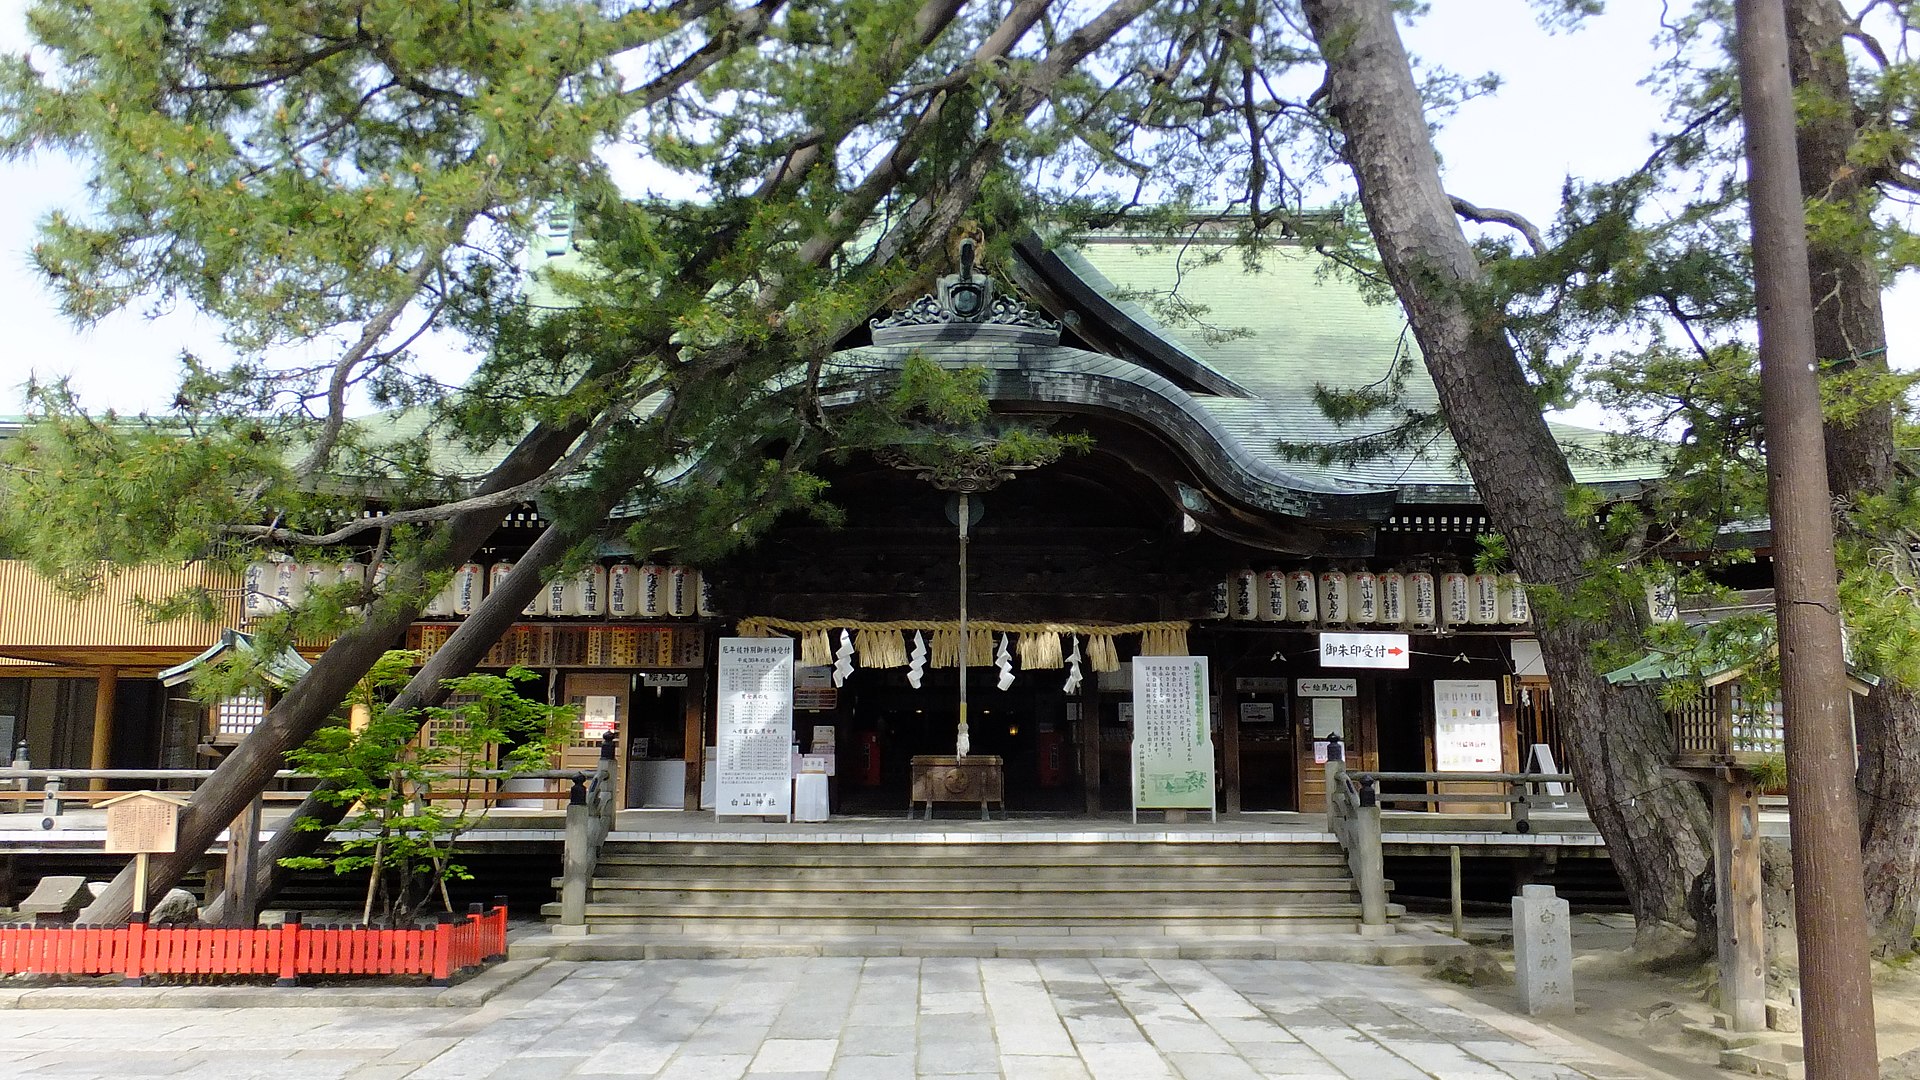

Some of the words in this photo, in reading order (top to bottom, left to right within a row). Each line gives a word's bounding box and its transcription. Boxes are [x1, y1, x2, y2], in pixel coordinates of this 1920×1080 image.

[1326, 643, 1386, 658] 御朱印受付
[1313, 684, 1353, 692] 絵馬記入所
[731, 798, 776, 806] 白山神社
[1540, 908, 1560, 995] 白山神社
